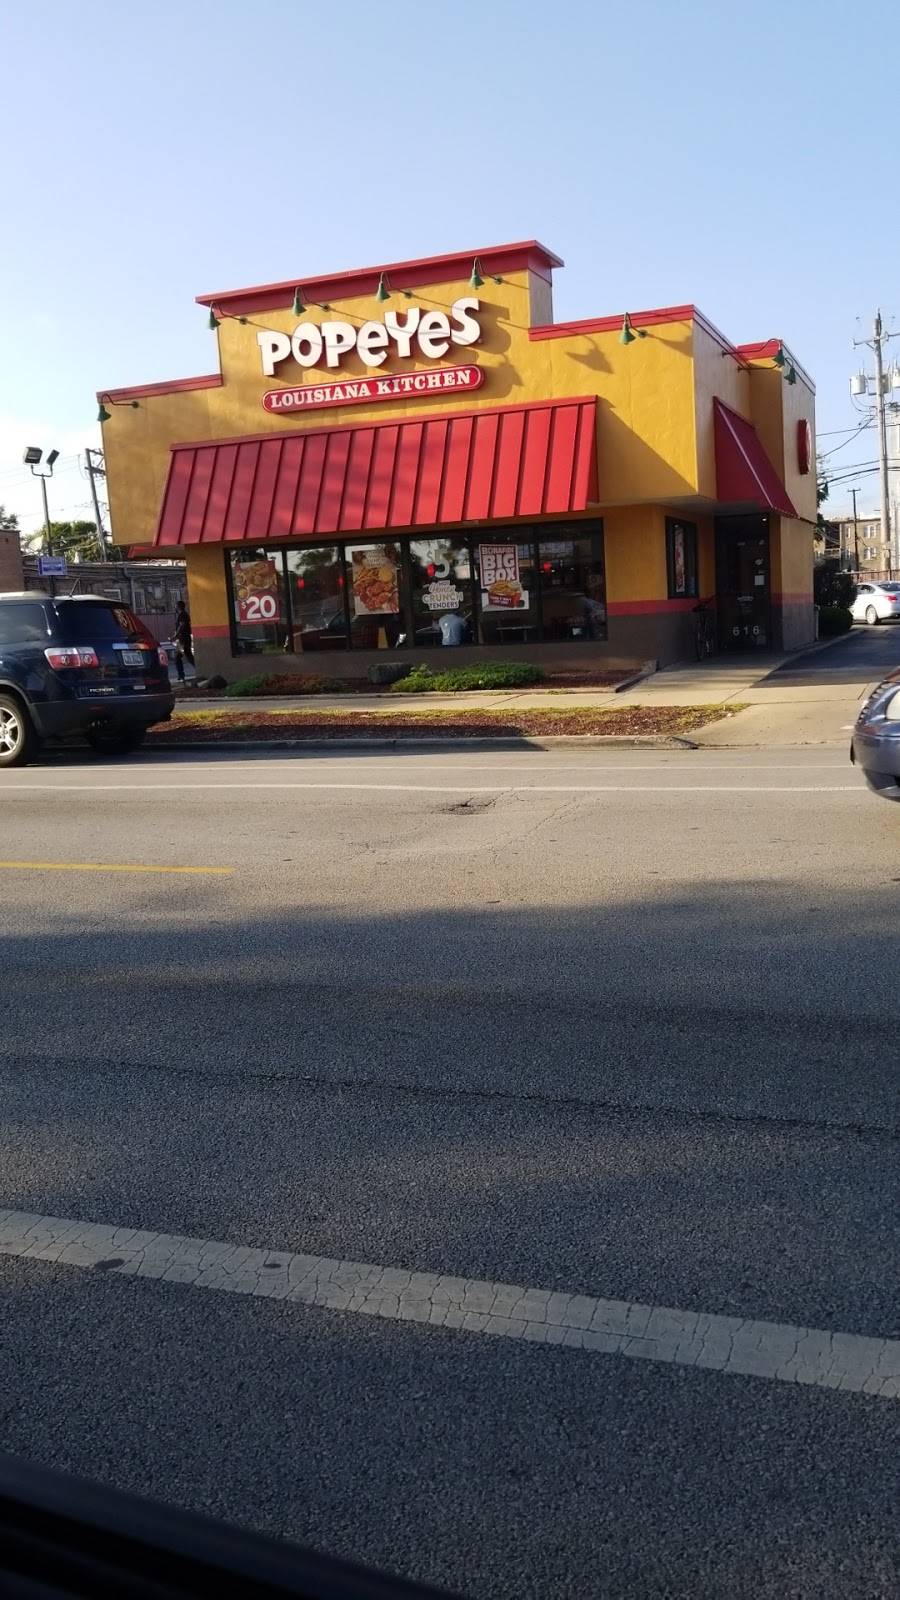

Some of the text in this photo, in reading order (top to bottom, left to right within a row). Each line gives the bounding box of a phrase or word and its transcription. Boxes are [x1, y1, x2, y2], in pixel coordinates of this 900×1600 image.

[270, 370, 472, 408] LOUISIANA KITCHEN
[482, 554, 515, 570] BIG
[483, 567, 517, 585] BOX
[422, 591, 464, 605] CRUNCH
[430, 601, 459, 609] TENDERS
[241, 595, 276, 620] $20
[732, 625, 761, 636] 616
